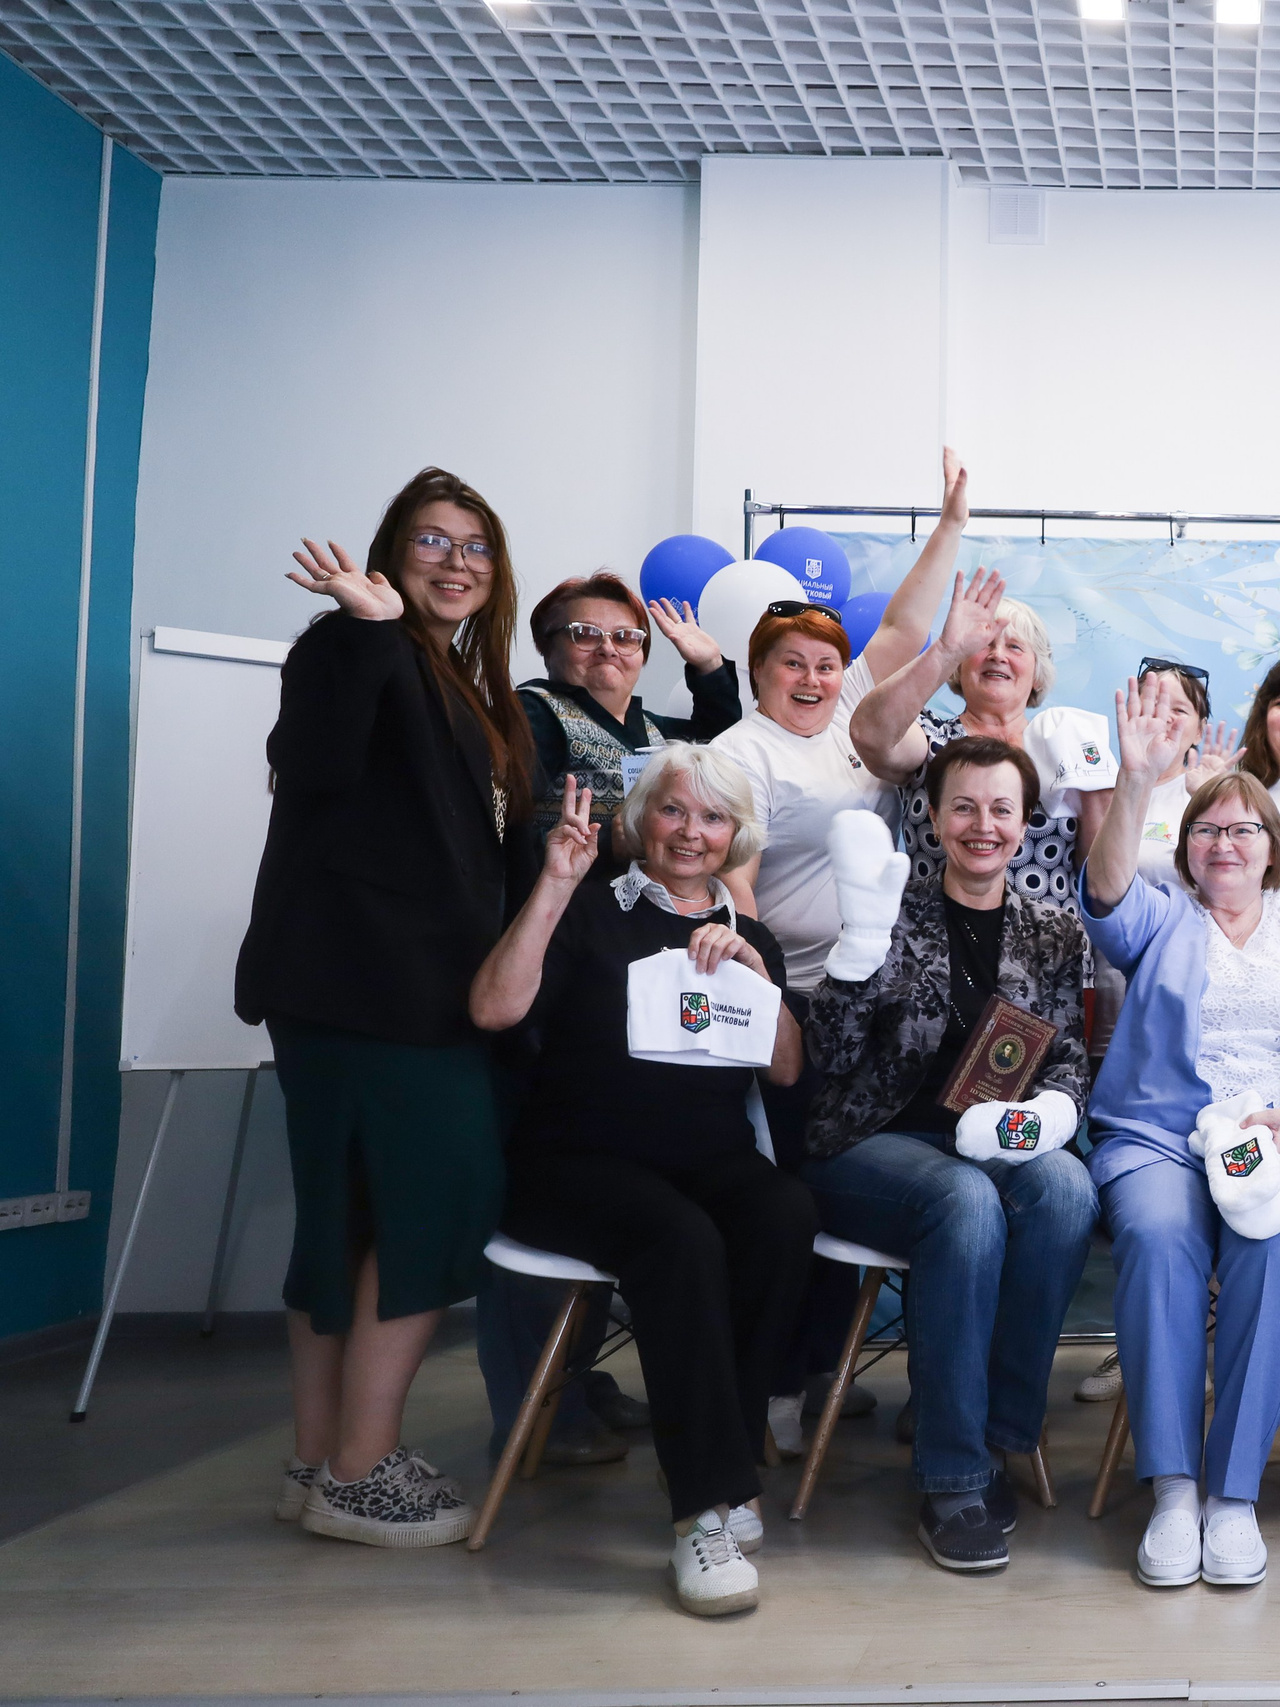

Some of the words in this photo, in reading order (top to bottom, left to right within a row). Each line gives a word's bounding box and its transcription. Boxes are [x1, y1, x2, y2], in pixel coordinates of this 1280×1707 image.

[798, 579, 834, 591] ЦИАЛЬНЫЙ
[805, 590, 832, 600] ТКОВЫЙ
[711, 1012, 750, 1028] АСТКОВЫЙ
[970, 1087, 996, 1102] ПУШКИ
